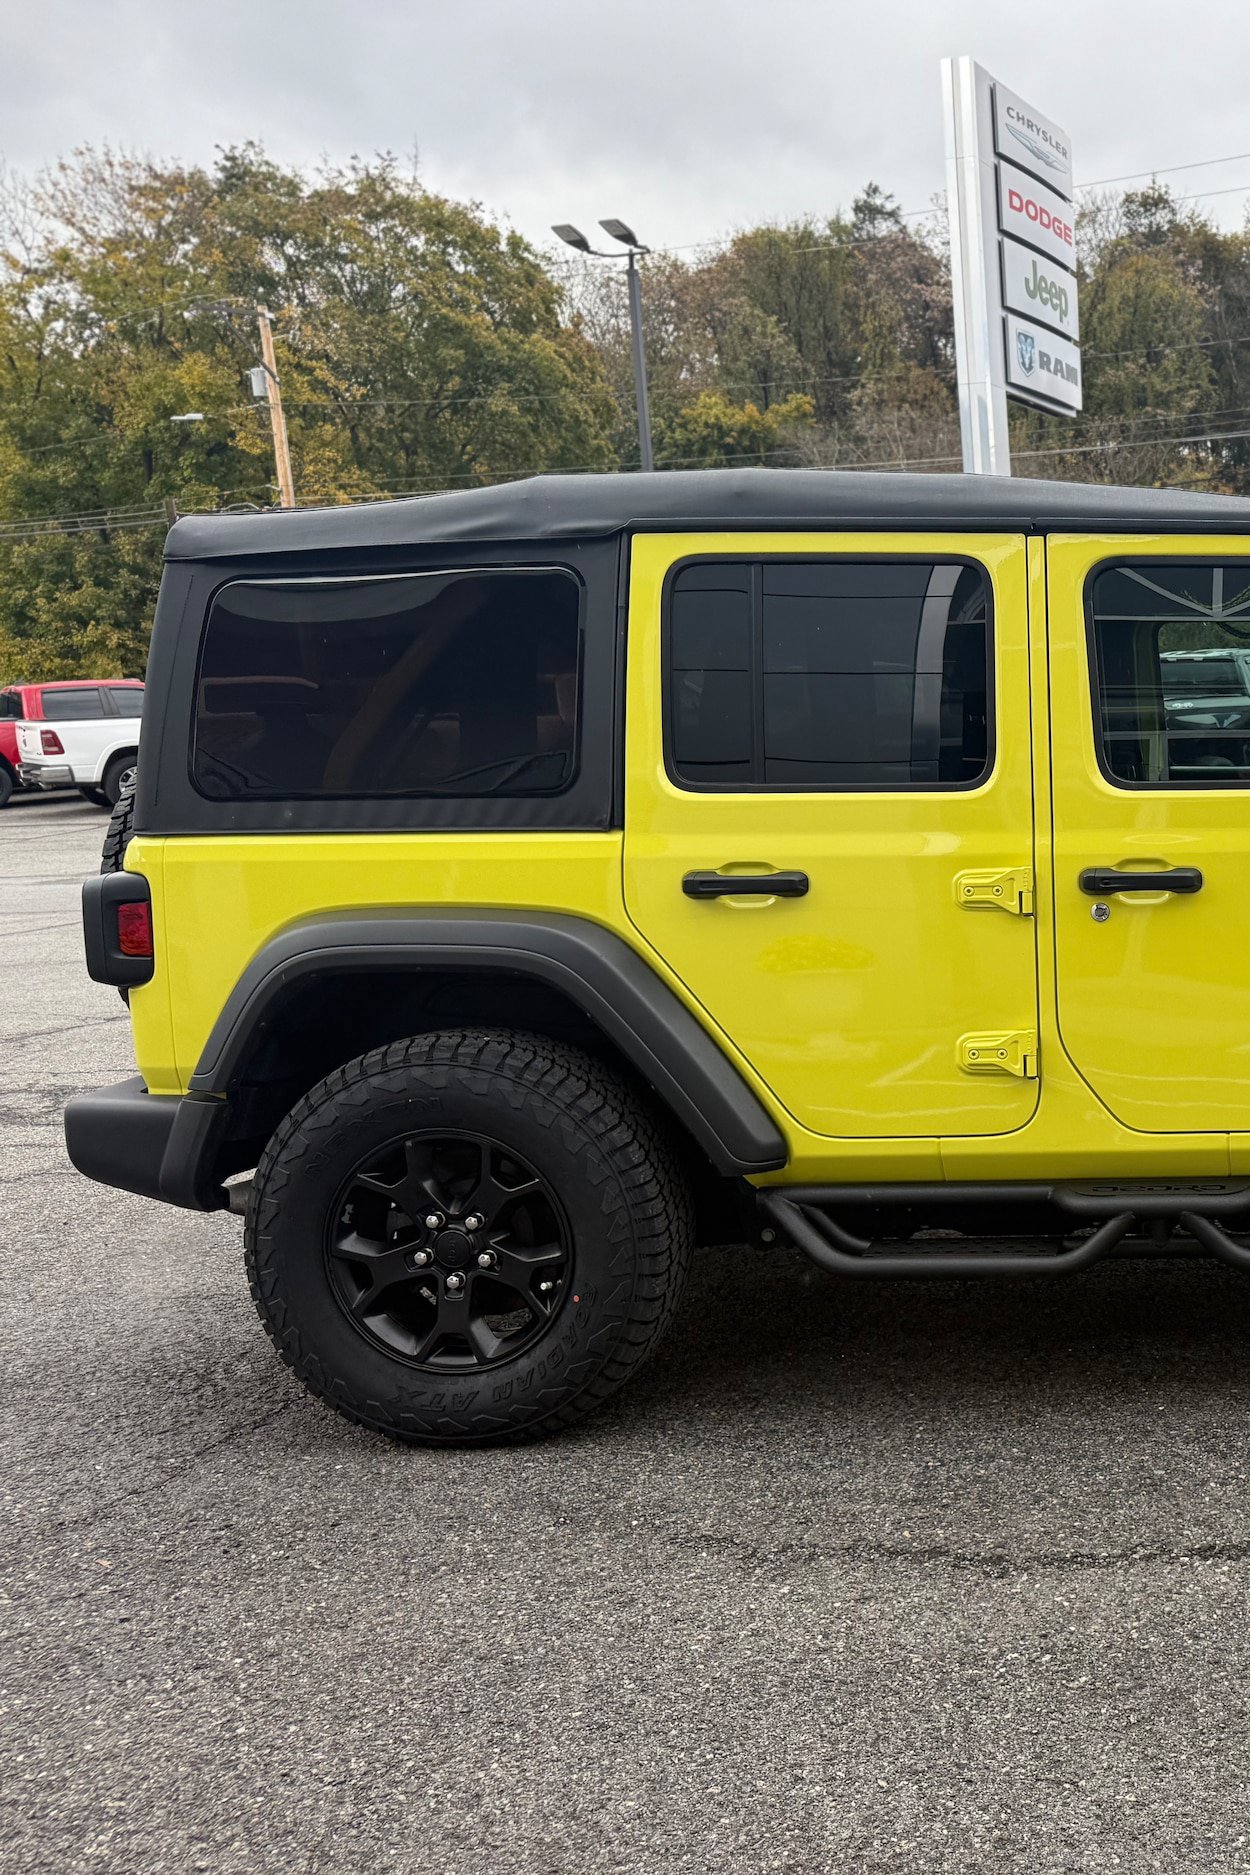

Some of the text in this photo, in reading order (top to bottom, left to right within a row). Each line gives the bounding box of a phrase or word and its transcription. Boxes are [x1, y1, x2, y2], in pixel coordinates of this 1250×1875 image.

[1006, 106, 1068, 160] CHRYSLER
[1008, 188, 1073, 247] DODGE
[1024, 259, 1068, 323] Jeep
[1038, 349, 1077, 386] RAM
